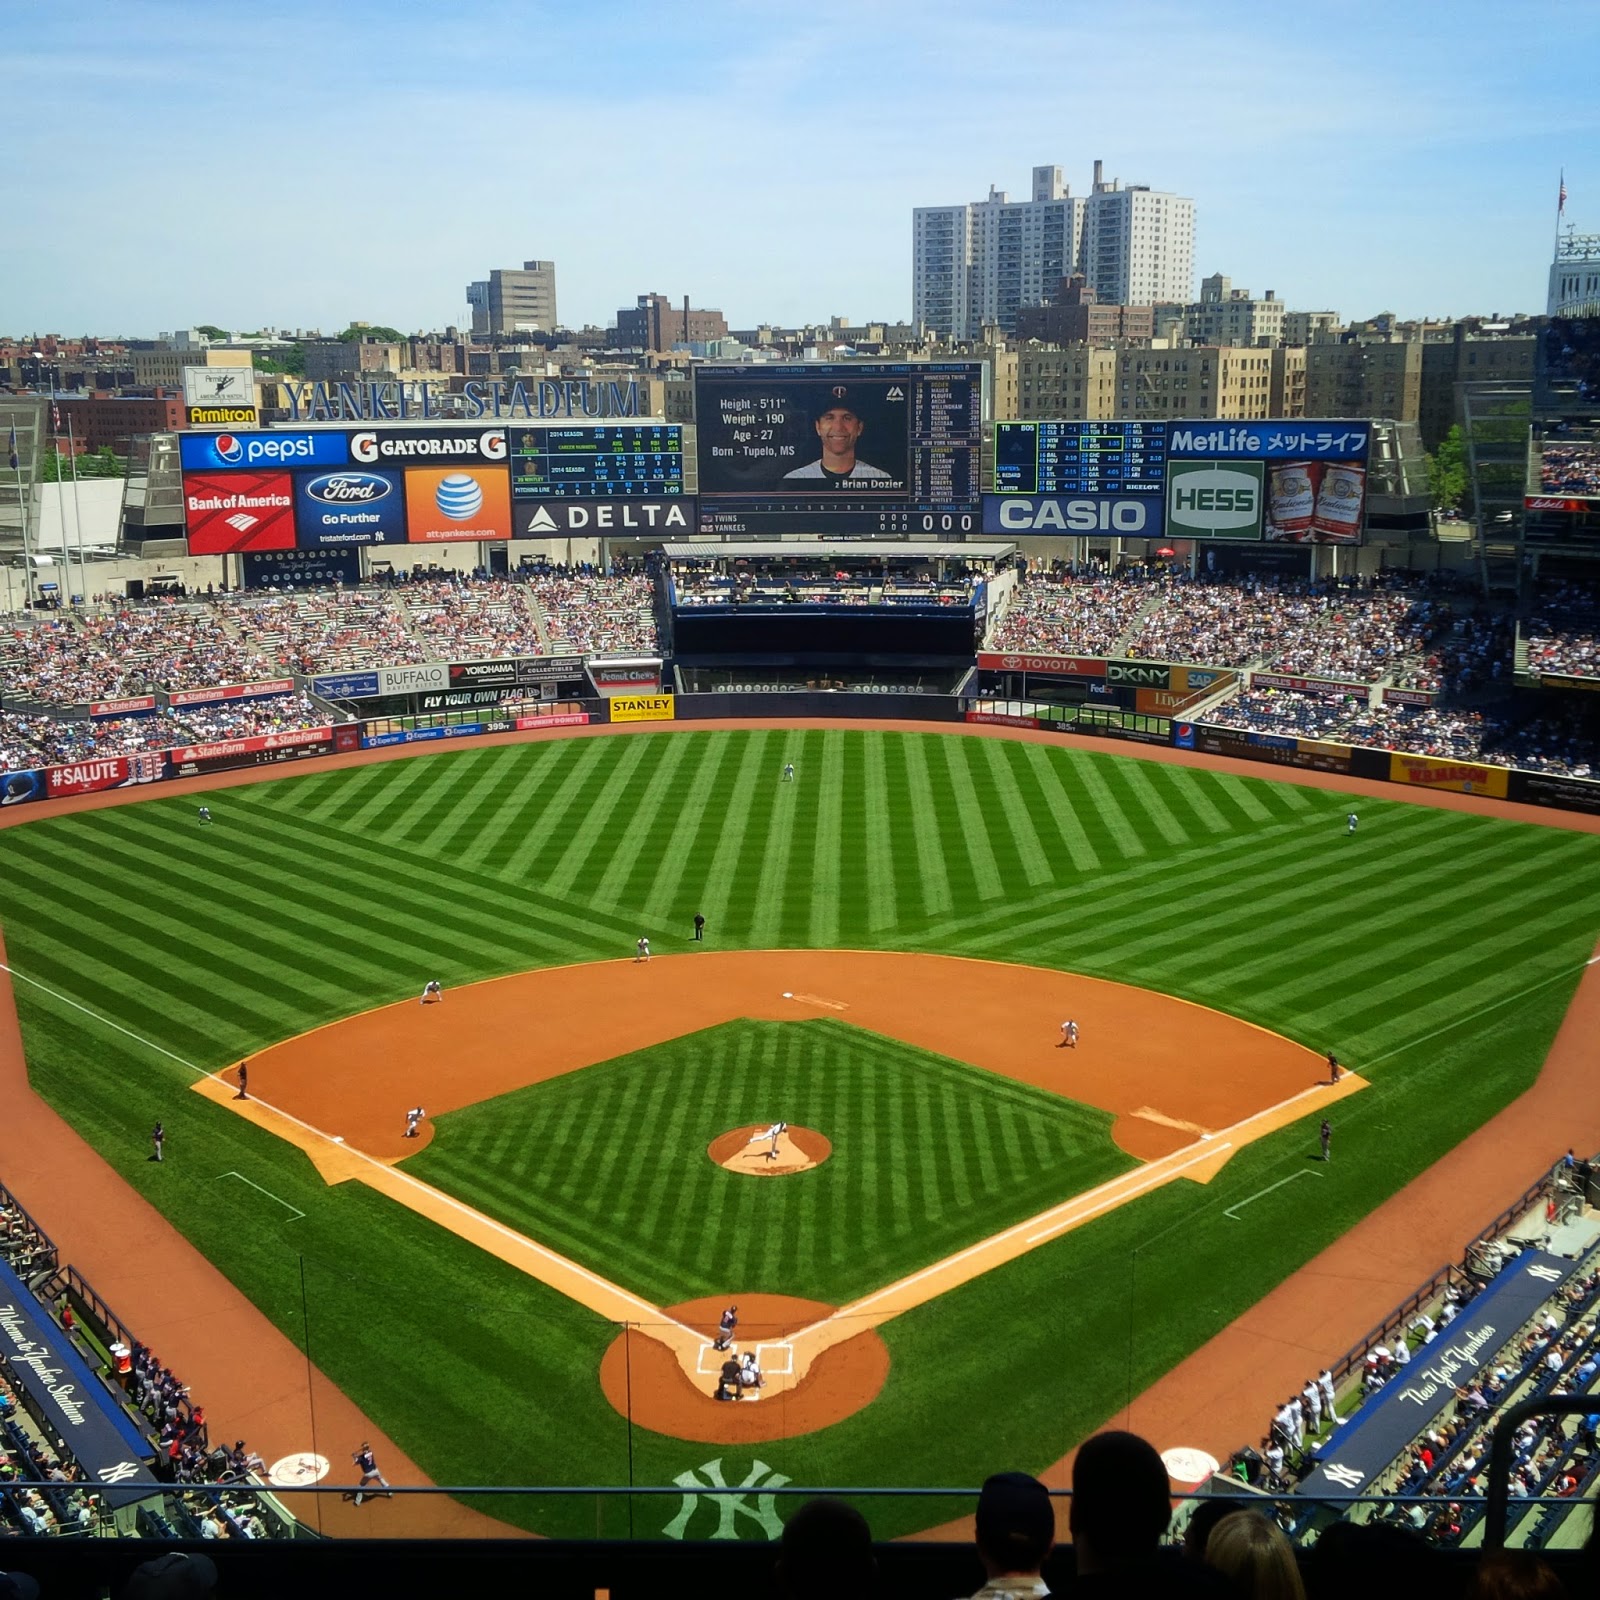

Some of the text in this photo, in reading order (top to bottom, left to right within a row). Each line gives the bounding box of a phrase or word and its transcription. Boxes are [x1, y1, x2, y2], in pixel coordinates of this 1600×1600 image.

[281, 381, 640, 421] YANKEE STADIUM
[720, 399, 785, 411] Height 5'11"
[191, 408, 254, 422] Armitron
[722, 414, 784, 426] Weight 190
[733, 430, 773, 442] Age 27
[1171, 428, 1260, 451] MetLife
[1268, 433, 1367, 451] メットライフ
[248, 435, 315, 462] pepsi
[380, 439, 477, 456] GATORADE
[712, 446, 794, 458] Born Tupelo, MS
[323, 477, 375, 500] Ford
[842, 480, 868, 489] Brian
[871, 480, 903, 489] Dozier
[188, 493, 291, 510] Bank of America
[1176, 488, 1254, 511] HESS
[322, 513, 380, 524] Go Further
[568, 505, 686, 528] DELTA
[923, 515, 971, 530] 0 0 0
[1000, 500, 1146, 531] CASIO
[320, 533, 371, 542] tristateford.com
[426, 528, 496, 537] att.yankees.com
[465, 664, 514, 674] YOKOHAMA
[1025, 659, 1077, 670] TOYOTA
[386, 669, 442, 685] BUFFALO
[601, 672, 655, 680] Peanut Chews
[1108, 666, 1169, 684] DKNY
[1188, 675, 1212, 686] SAP
[1254, 676, 1291, 686] MODELL'S
[1091, 684, 1113, 694] FedEx
[424, 688, 523, 708] FLY YOUR OWN FLAG
[614, 700, 670, 711] STANLEY
[378, 736, 399, 744] Experian
[52, 761, 119, 786] #SALUTE
[0, 1304, 85, 1426] Welcome to Yankee Stadium
[1398, 1324, 1496, 1406] New York Yankees
[662, 1457, 793, 1540] NY
